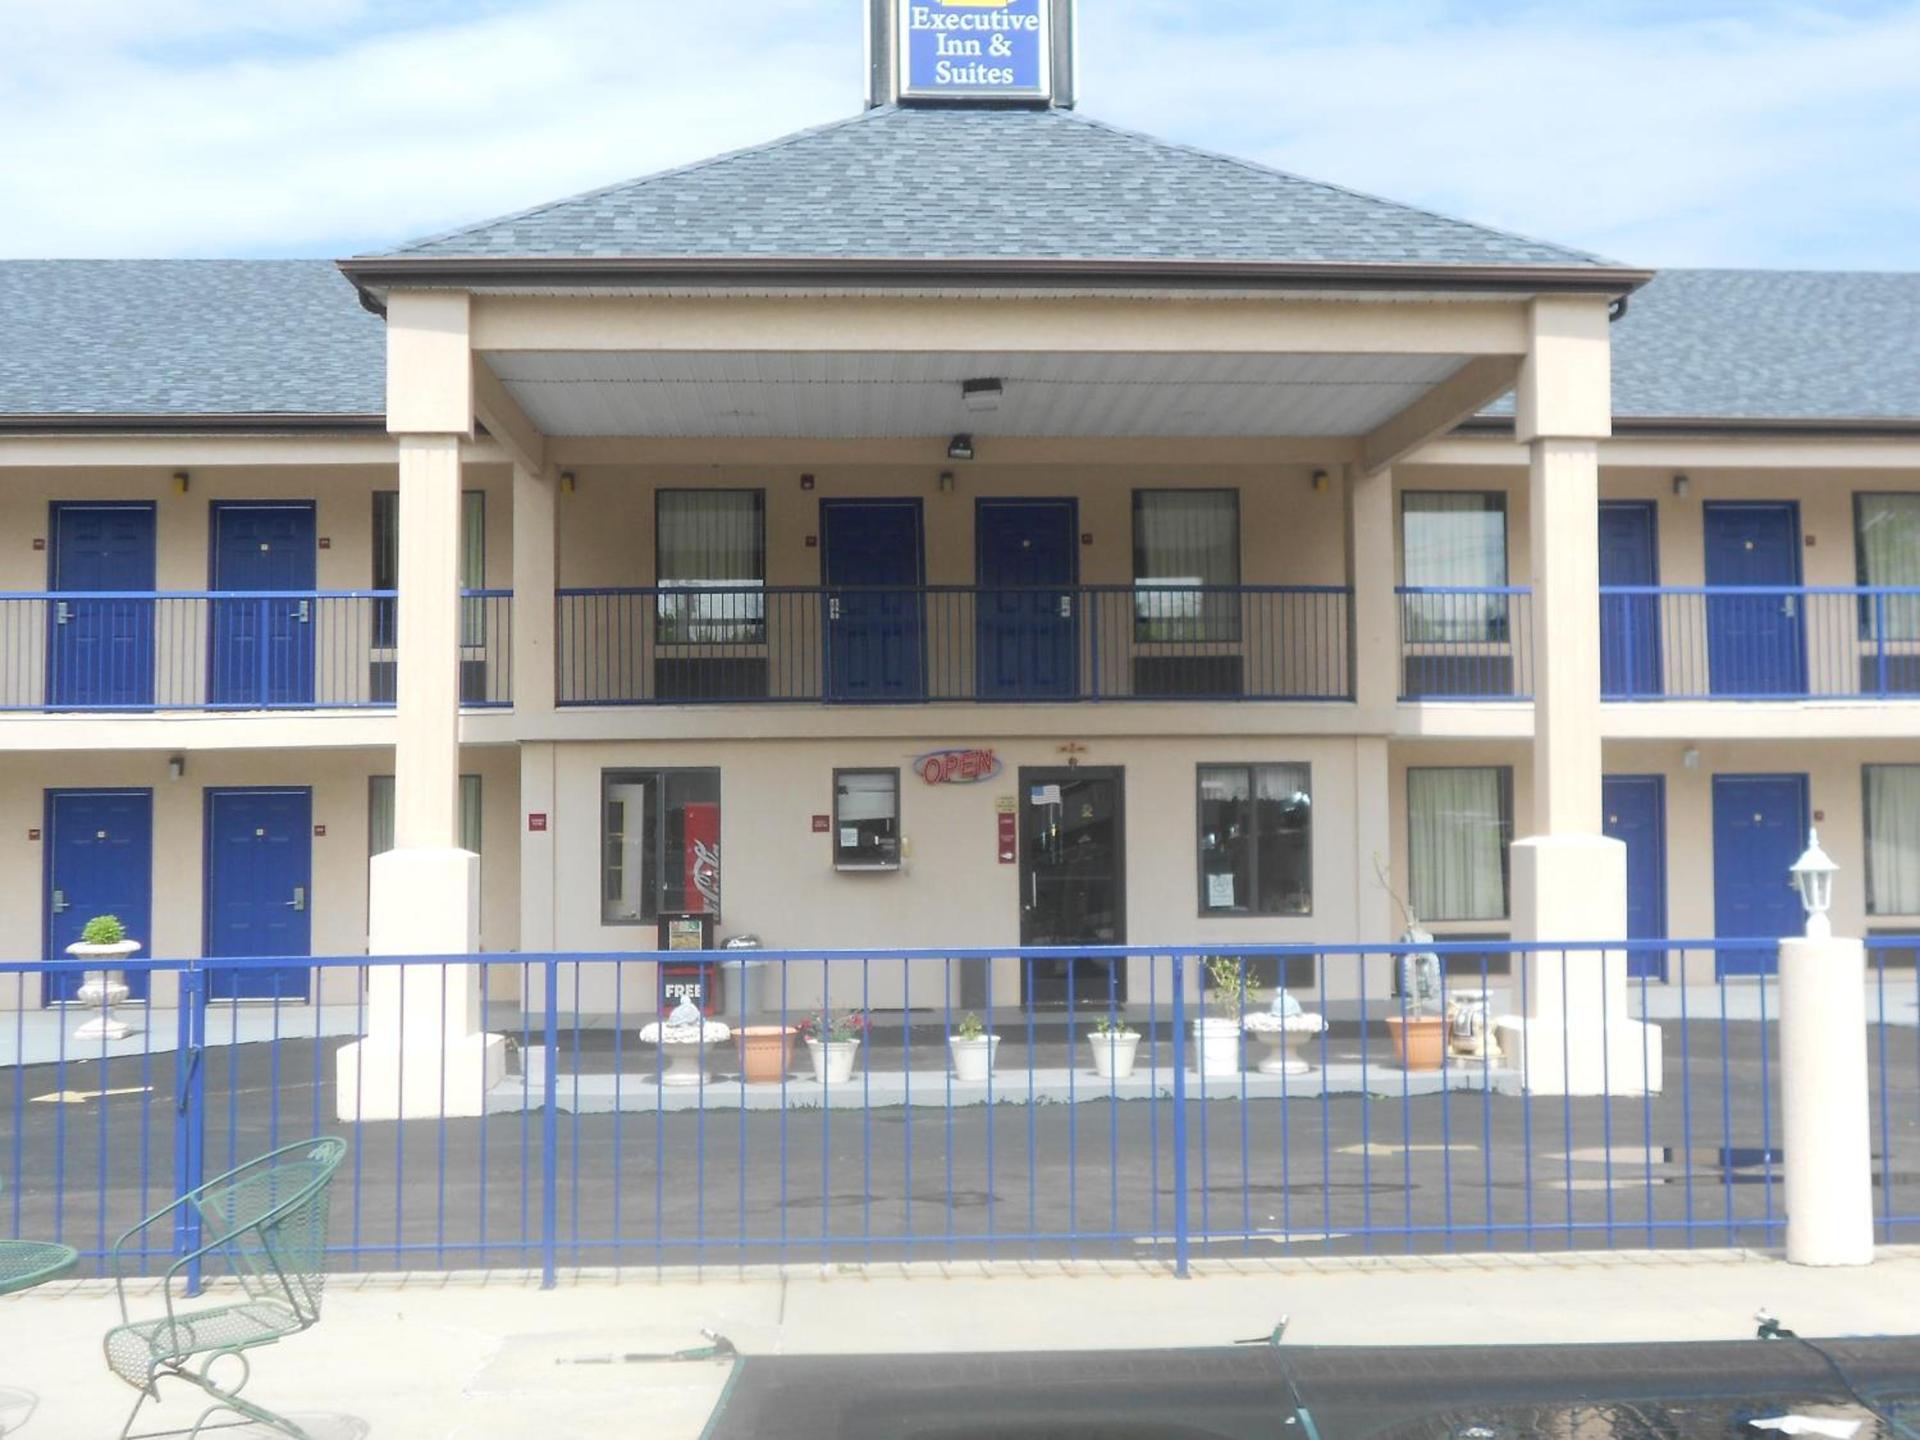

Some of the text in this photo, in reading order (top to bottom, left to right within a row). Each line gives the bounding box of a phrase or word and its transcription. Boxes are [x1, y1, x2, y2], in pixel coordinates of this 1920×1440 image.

[911, 6, 1039, 31] Executive
[936, 32, 1013, 57] Inn &
[935, 60, 1014, 84] Suites
[923, 748, 993, 786] OPEN
[665, 983, 701, 998] FREE
